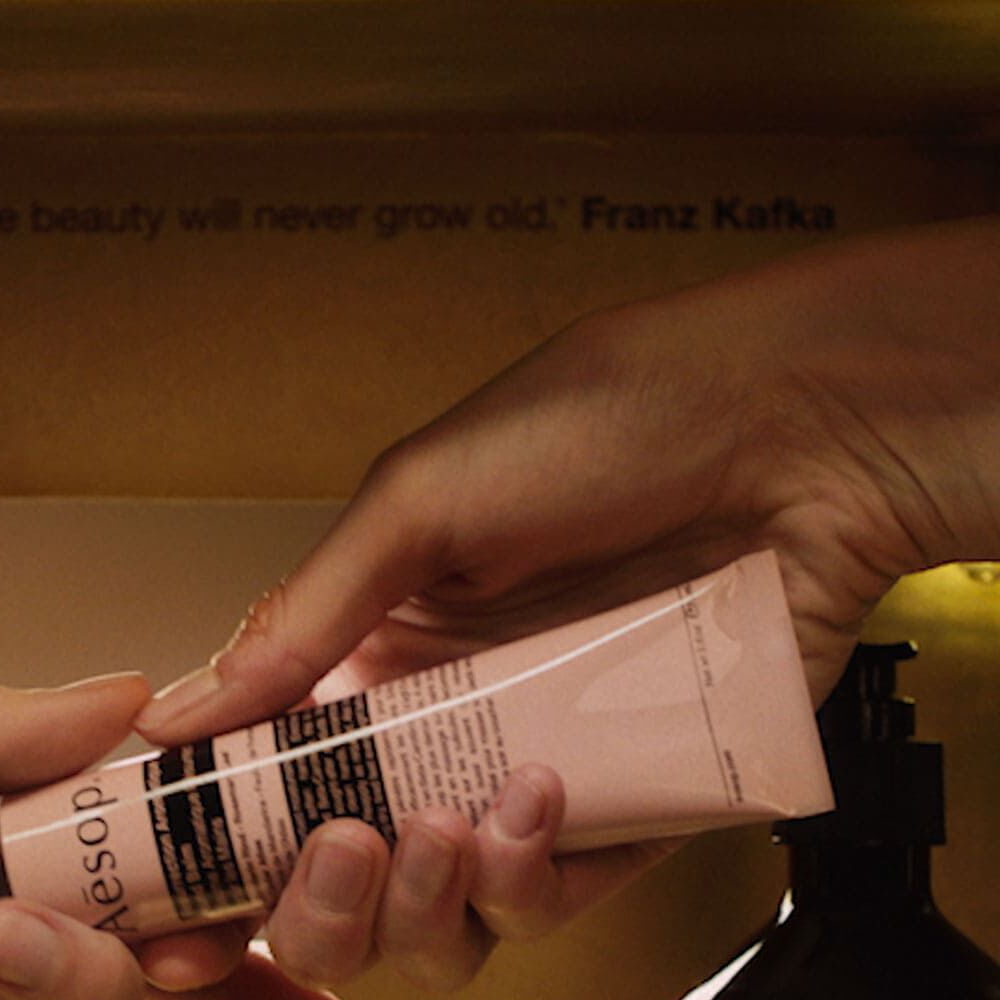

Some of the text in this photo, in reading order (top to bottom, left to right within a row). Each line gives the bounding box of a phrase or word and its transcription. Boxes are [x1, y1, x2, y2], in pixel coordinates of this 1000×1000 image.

[30, 199, 165, 240] beauty
[254, 203, 362, 232] never
[373, 203, 474, 238] grow
[581, 196, 698, 231] Franz
[711, 195, 836, 231] Kafka
